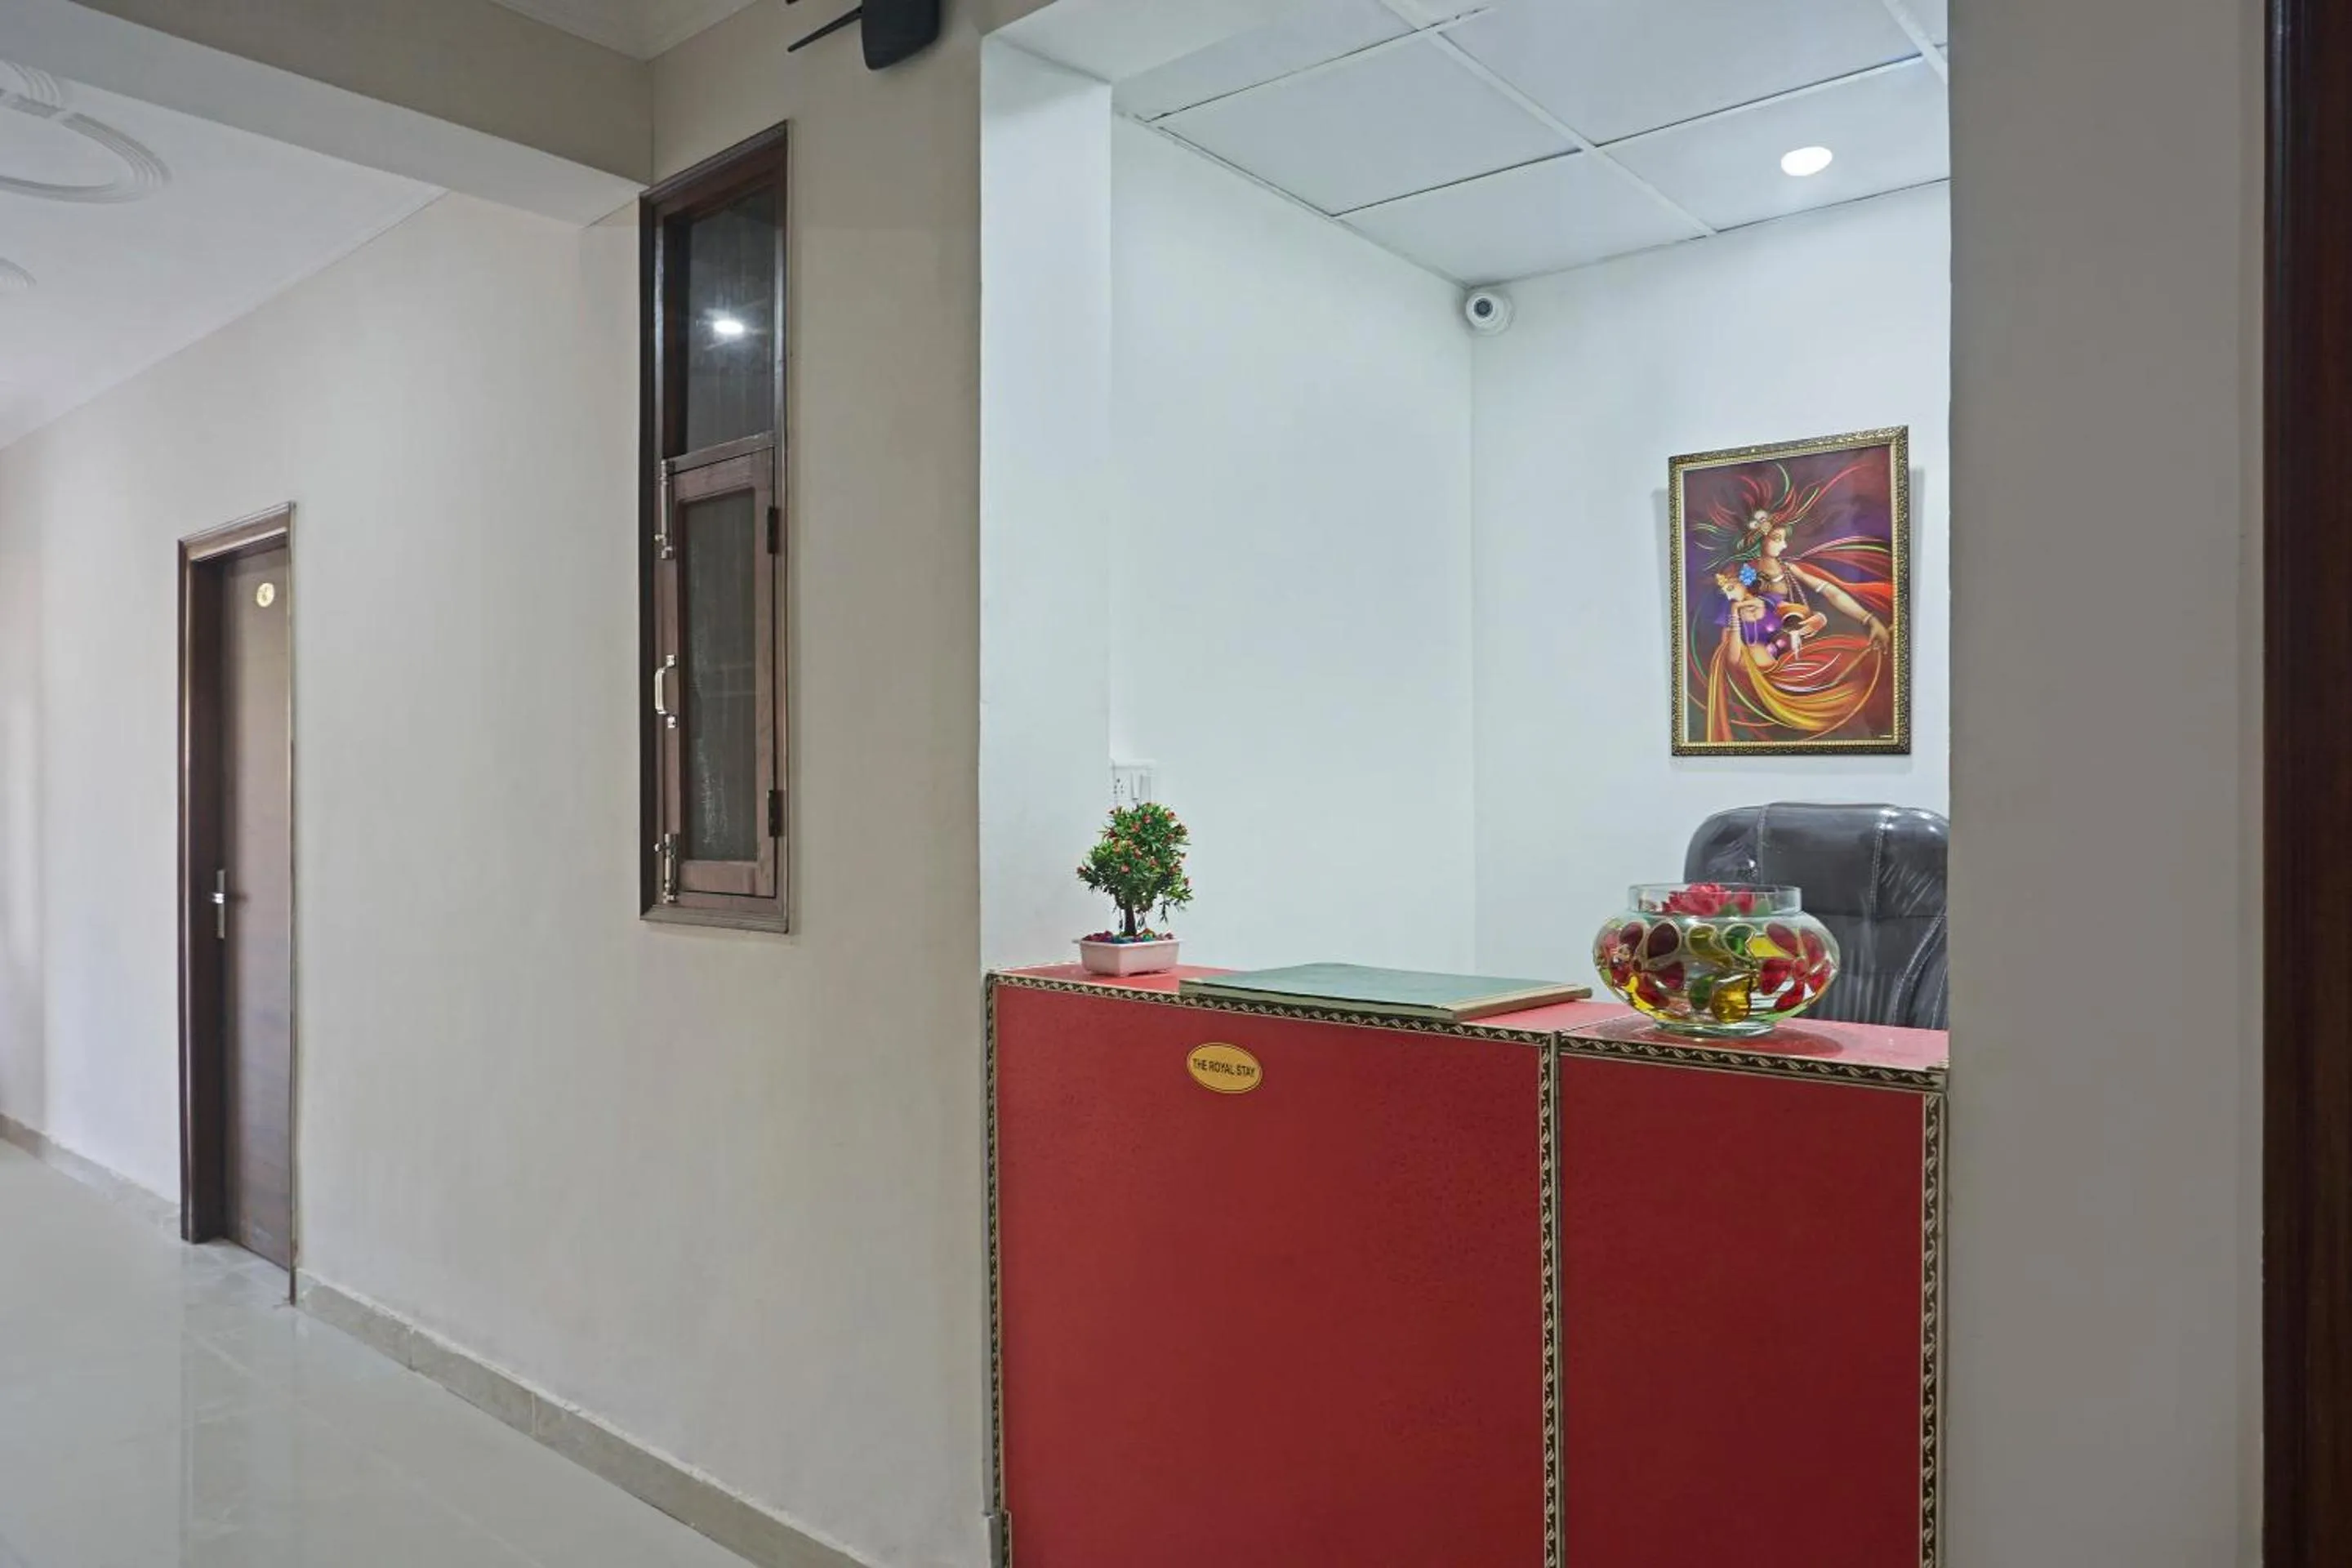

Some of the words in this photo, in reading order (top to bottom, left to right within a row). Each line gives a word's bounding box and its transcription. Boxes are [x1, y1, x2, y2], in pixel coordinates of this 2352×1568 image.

[1192, 1058, 1208, 1071] THE
[1209, 1061, 1235, 1076] ROYAL
[1236, 1064, 1255, 1077] STAY
